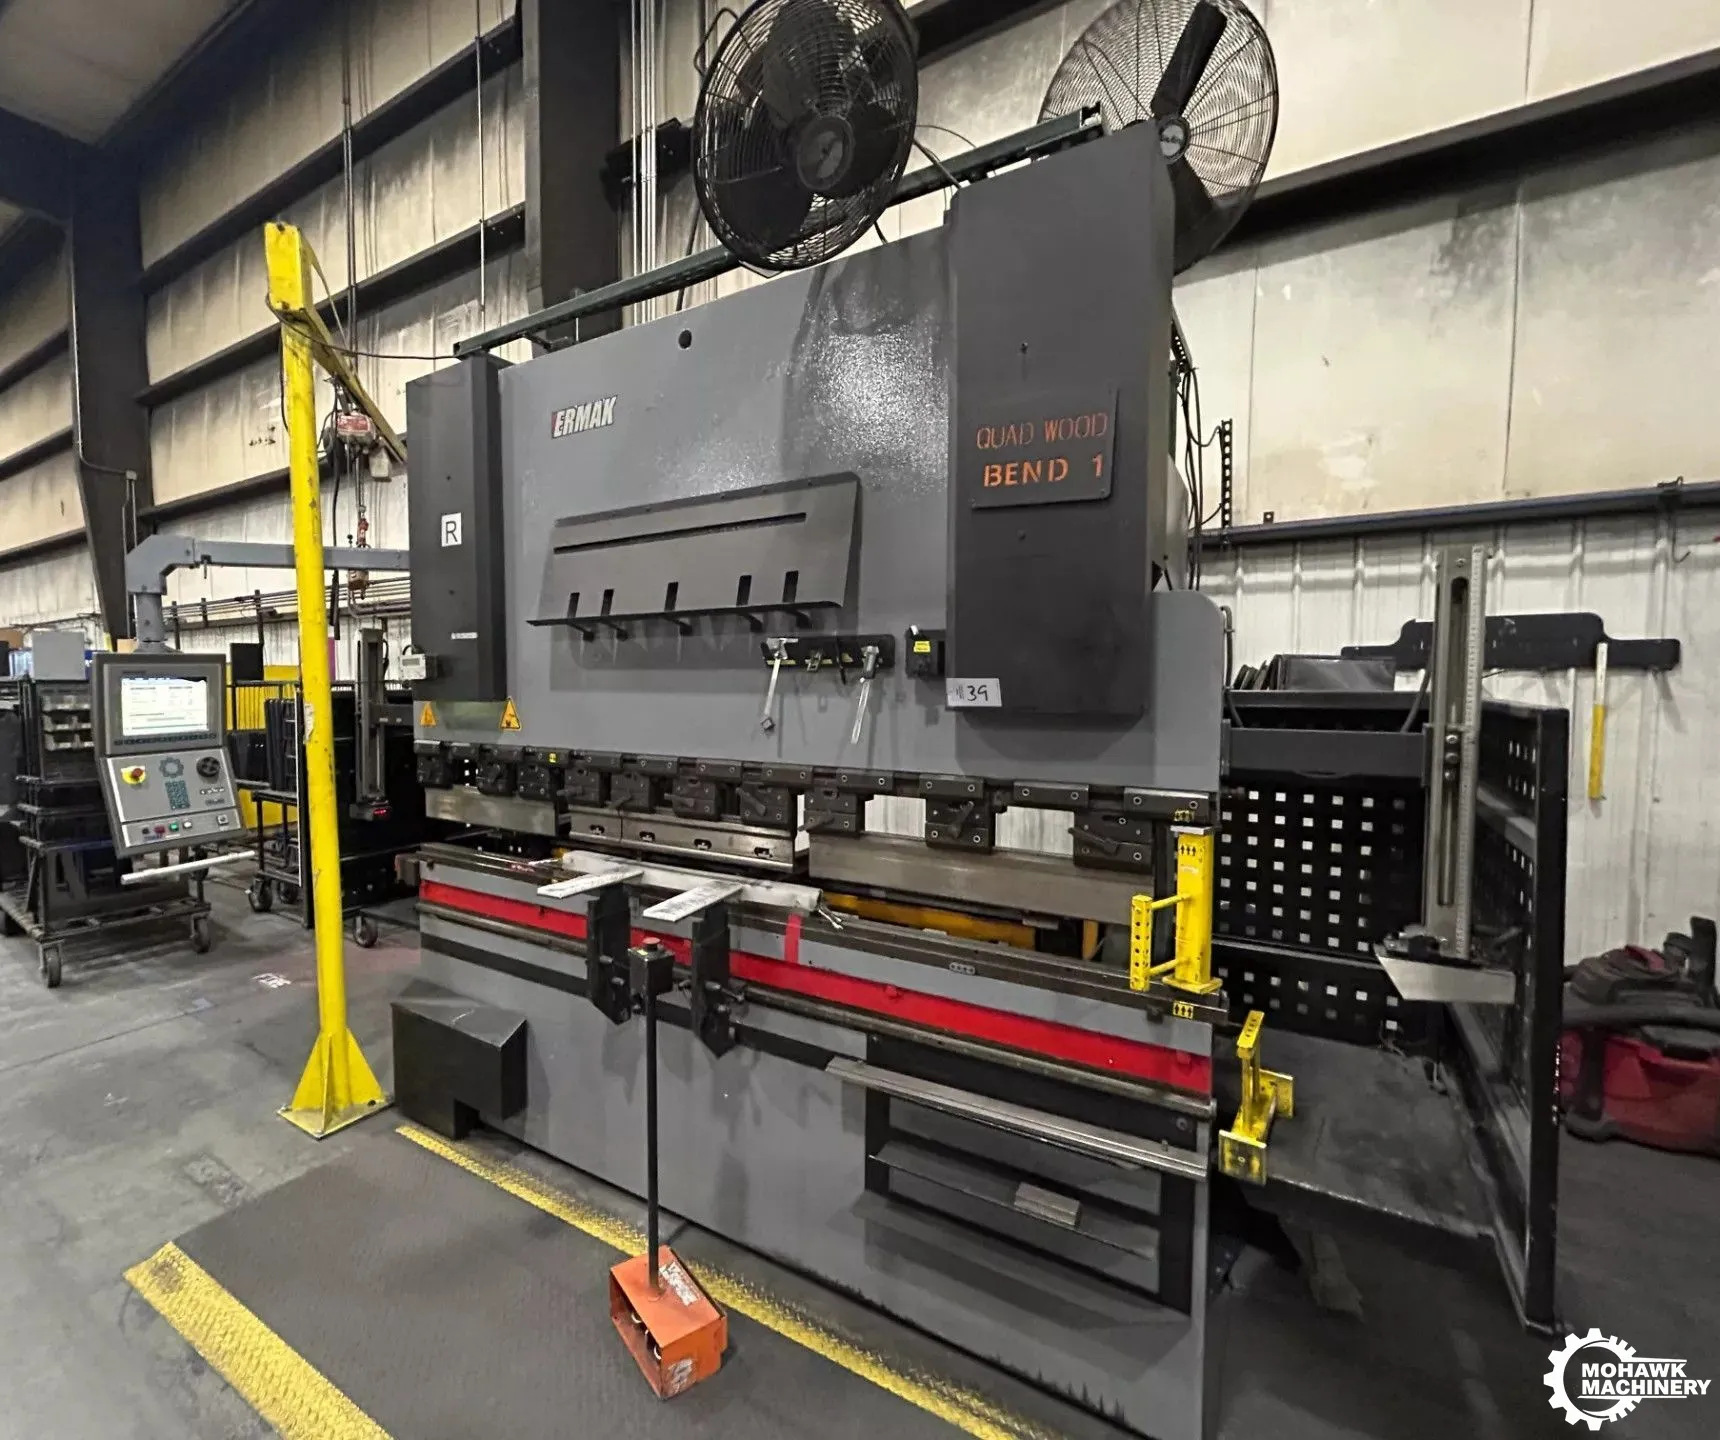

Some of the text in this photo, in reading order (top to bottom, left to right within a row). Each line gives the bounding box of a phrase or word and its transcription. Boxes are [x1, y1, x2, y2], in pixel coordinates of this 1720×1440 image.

[553, 396, 617, 438] ERMAK
[976, 413, 1108, 450] QUAD WOOD
[983, 453, 1104, 487] BEND 1
[445, 520, 458, 544] R
[967, 684, 989, 701] 39
